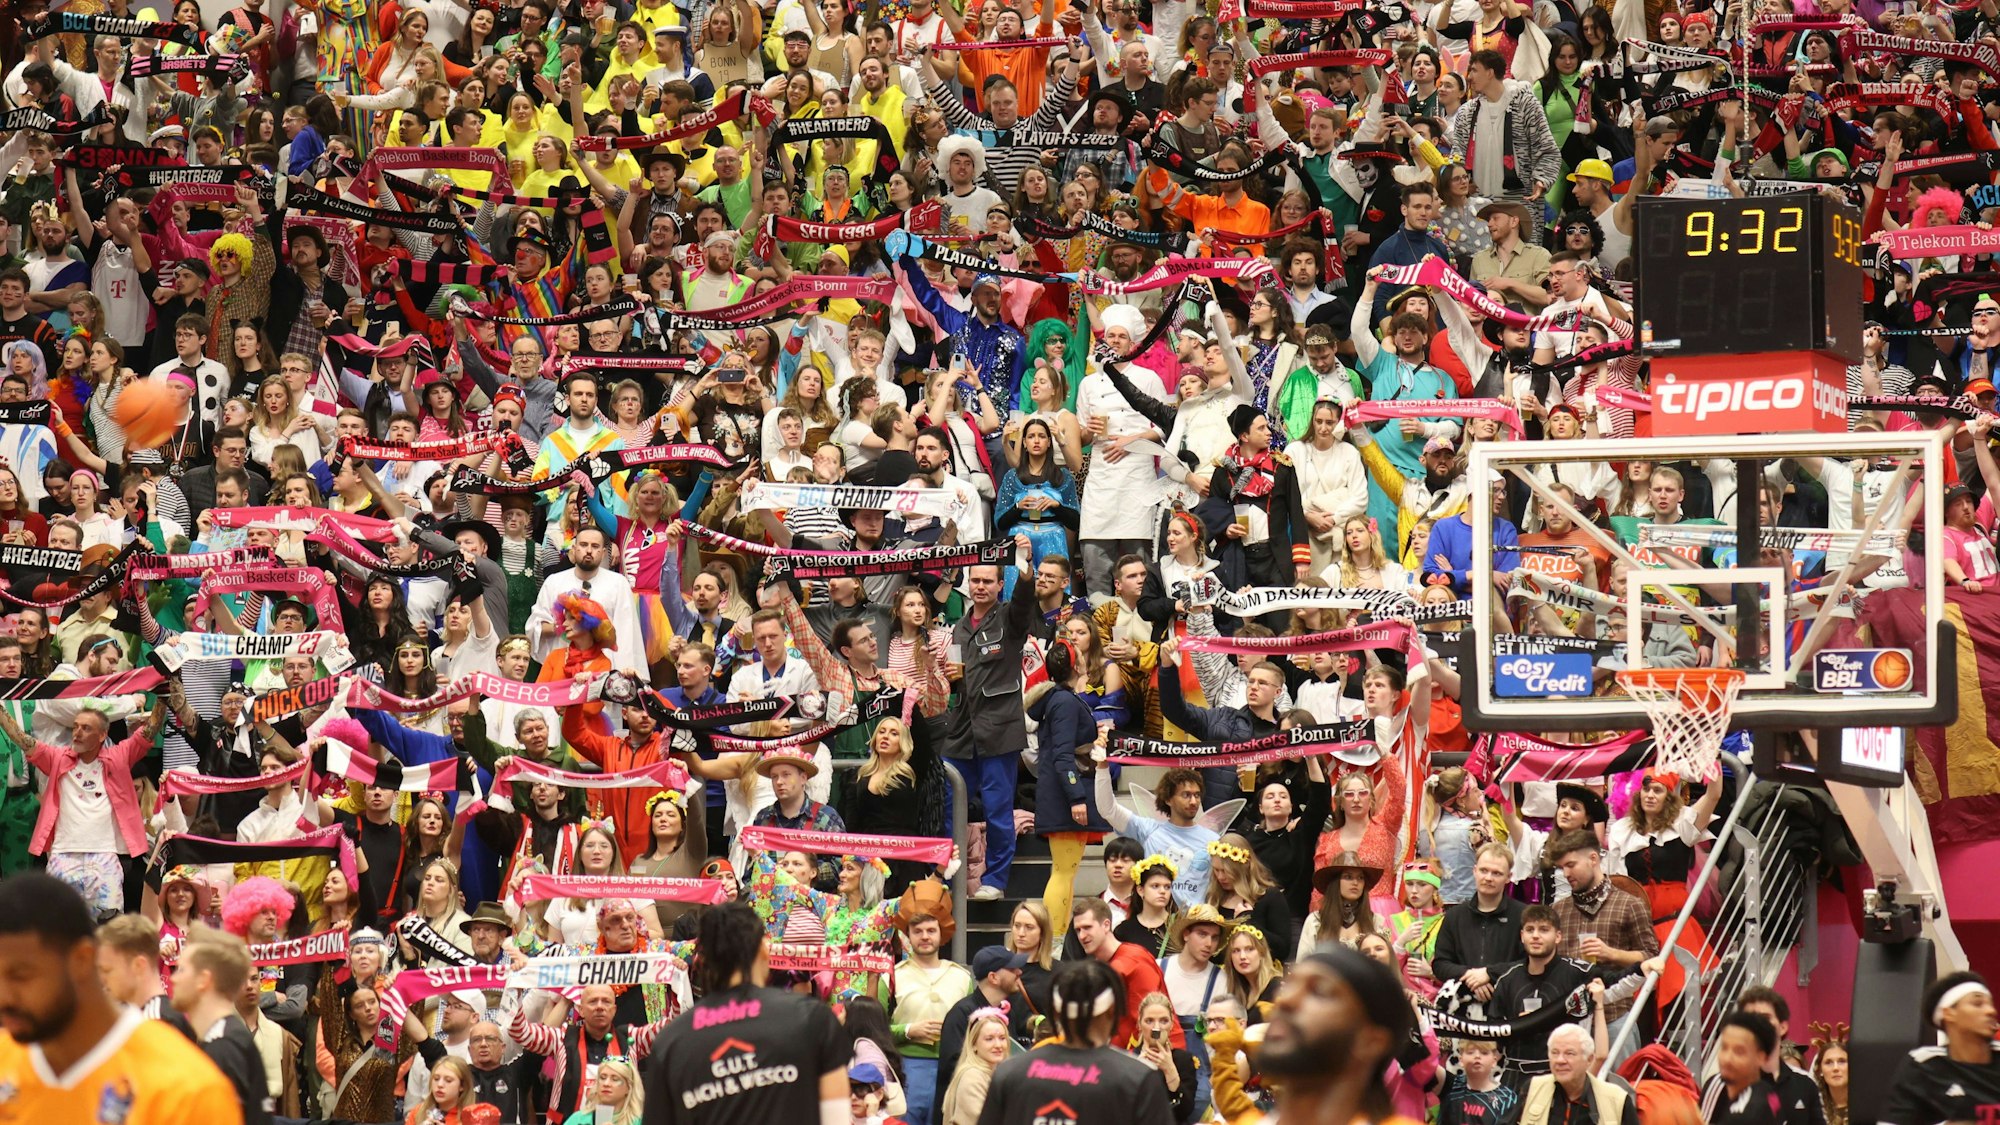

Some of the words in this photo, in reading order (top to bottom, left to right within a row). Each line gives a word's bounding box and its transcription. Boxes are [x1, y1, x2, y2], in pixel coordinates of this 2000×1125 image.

[1252, 1, 1293, 12] Telekom
[1334, 1, 1360, 12] Bonn
[63, 12, 91, 32] BCL
[93, 15, 151, 35] CHAMP
[1852, 32, 1910, 50] TELEKOM
[1914, 39, 1973, 58] BASKETS
[160, 59, 207, 70] BASKETS
[710, 56, 738, 69] BONN
[1252, 53, 1304, 69] Telekom
[1355, 49, 1388, 61] Bonn
[717, 69, 731, 83] 19
[1862, 82, 1926, 95] BASKETS
[1912, 95, 1932, 107] Mein
[6, 110, 53, 131] CHAMP
[680, 109, 719, 131] 1995
[788, 117, 872, 137] #HEARTBERG
[372, 150, 420, 164] Telekom
[468, 149, 497, 165] Bonn
[1894, 159, 1915, 171] TEAM.
[148, 169, 223, 185] #HEARTBERG
[171, 184, 228, 198] Telekom
[322, 200, 373, 220] Telekom
[427, 216, 459, 231] Bonn
[799, 223, 831, 241] SEIT
[838, 222, 876, 240] 1995
[1686, 207, 1804, 257] 9:32
[1832, 214, 1862, 267] 9:32
[1897, 233, 1966, 251] Telekom
[1971, 231, 2000, 247] Bas
[715, 299, 768, 321] Telekom
[814, 281, 848, 293] Bonn
[1439, 267, 1471, 297] SEIT
[1471, 292, 1506, 319] 1995
[601, 300, 635, 313] Bonn
[1375, 400, 1427, 408] TELEKOM
[1429, 399, 1479, 407] BASKETS
[1656, 372, 1805, 421] tipico
[1812, 369, 1847, 420] tipico
[354, 445, 381, 458] Meine
[381, 446, 406, 459] Liebe
[411, 447, 438, 460] Meine
[438, 444, 461, 458] Stadt
[465, 440, 489, 455] Mein
[623, 450, 644, 465] ONE
[644, 448, 670, 462] TEAM.
[671, 446, 691, 460] ONE
[797, 487, 830, 507] BCL
[831, 488, 893, 509] CHAMP
[896, 490, 920, 511] '23
[1759, 530, 1805, 550] HAMP
[1810, 533, 1833, 551] '23
[2, 550, 81, 572] #HEARTBER
[170, 551, 234, 568] BASKETS
[793, 554, 867, 570] Telekom
[869, 548, 932, 565] Baskets
[935, 544, 979, 559] Bonn
[793, 568, 821, 579] MEINE
[822, 566, 846, 577] LIEBE
[854, 564, 881, 575] MEINE
[883, 562, 912, 573] STADT
[922, 559, 943, 570] MEIN
[945, 555, 978, 567] VEREIN
[246, 569, 297, 585] Baskets
[297, 567, 323, 592] Bonn
[1350, 588, 1408, 606] BONN
[1546, 590, 1594, 613] MIR
[202, 634, 234, 657] BCL
[235, 635, 294, 656] CHAMP
[296, 632, 322, 655] '23
[1231, 635, 1291, 648] Telekom
[1294, 630, 1350, 647] Baskets
[1352, 627, 1389, 642] Bonn
[1833, 660, 1863, 671] Credit
[1525, 673, 1587, 692] Credit
[1821, 670, 1863, 688] BBL
[398, 674, 550, 711] #HEARTBERG
[253, 685, 305, 723] HÜCK
[692, 705, 743, 721] Baskets
[743, 699, 778, 713] Bonn
[713, 738, 733, 750] ONE
[733, 739, 757, 751] TEAM.
[761, 739, 781, 751] ONE
[780, 723, 834, 749] #HEARTBER
[1149, 741, 1217, 755] Telekom
[1220, 733, 1288, 752] Baskets
[1289, 727, 1335, 744] Bonn
[1178, 757, 1227, 768] Rausgehen
[1274, 748, 1305, 761] Siegen
[782, 833, 831, 843] TELEKOM
[833, 835, 880, 846] BASKETS
[882, 838, 916, 849] BONN
[553, 874, 610, 884] TELEKOM
[610, 875, 665, 886] BASKETS
[667, 877, 703, 888] BONN
[576, 886, 601, 894] Heimat.
[602, 886, 633, 895] Herzblut.
[634, 886, 679, 896] #HEARTBERG
[250, 937, 303, 961] SKETS
[769, 943, 843, 960] ASKETS
[790, 959, 819, 968] Stadt
[830, 957, 859, 969] Mein
[860, 958, 891, 970] Verein
[425, 965, 471, 988] SEIT
[536, 964, 575, 988] BCL
[577, 960, 649, 984] CHAMP
[739, 1063, 799, 1090] WESCO
